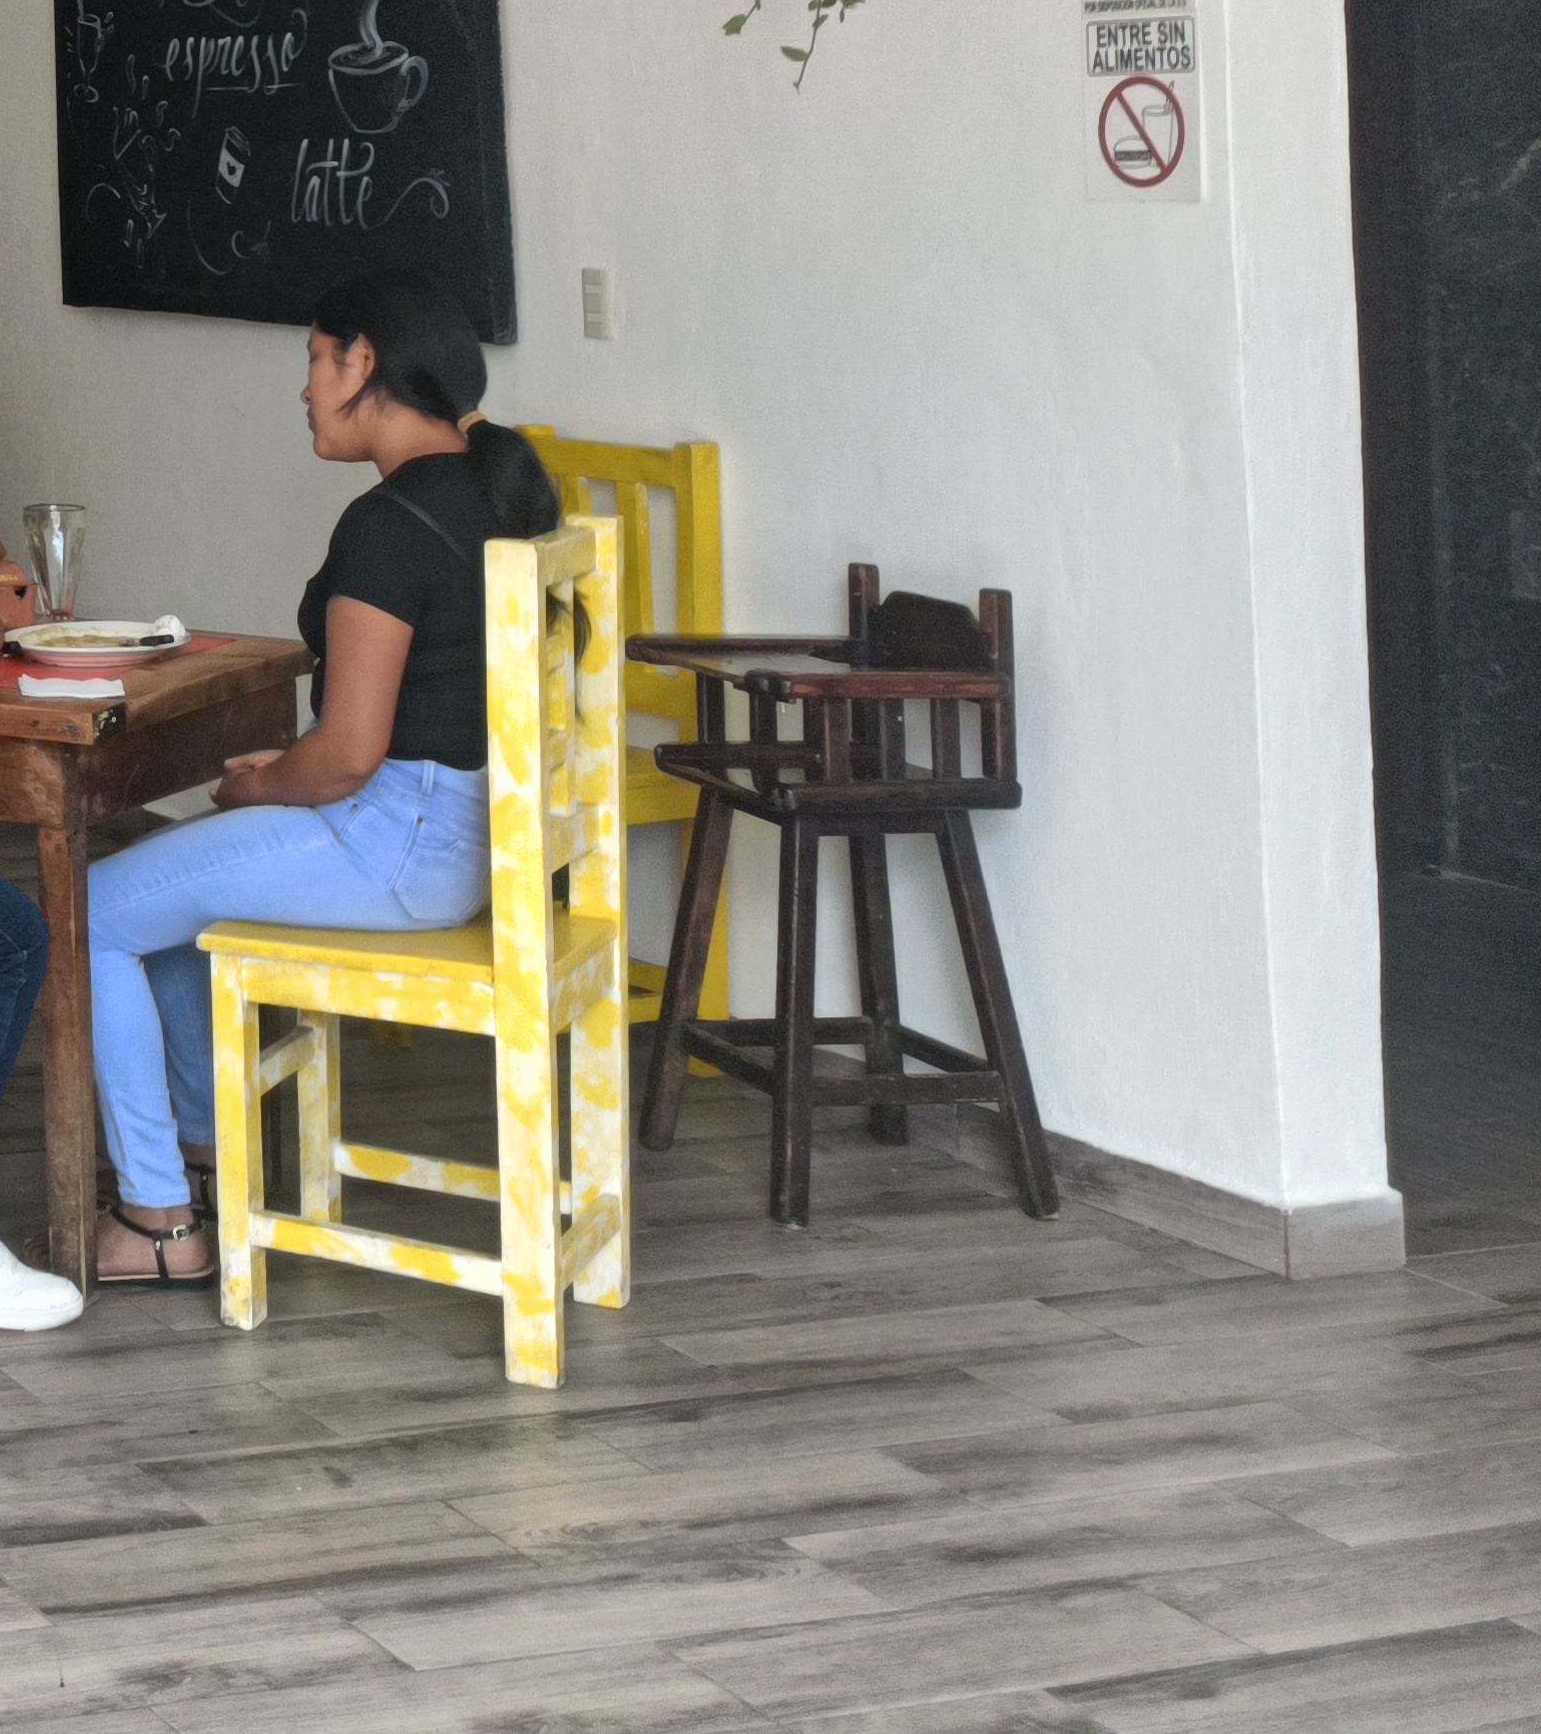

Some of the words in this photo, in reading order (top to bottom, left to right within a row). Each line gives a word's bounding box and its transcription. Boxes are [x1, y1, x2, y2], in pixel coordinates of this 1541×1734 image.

[1097, 21, 1152, 48] ENTRE
[1158, 19, 1186, 46] SIN
[1092, 45, 1191, 74] ALIMENTOS
